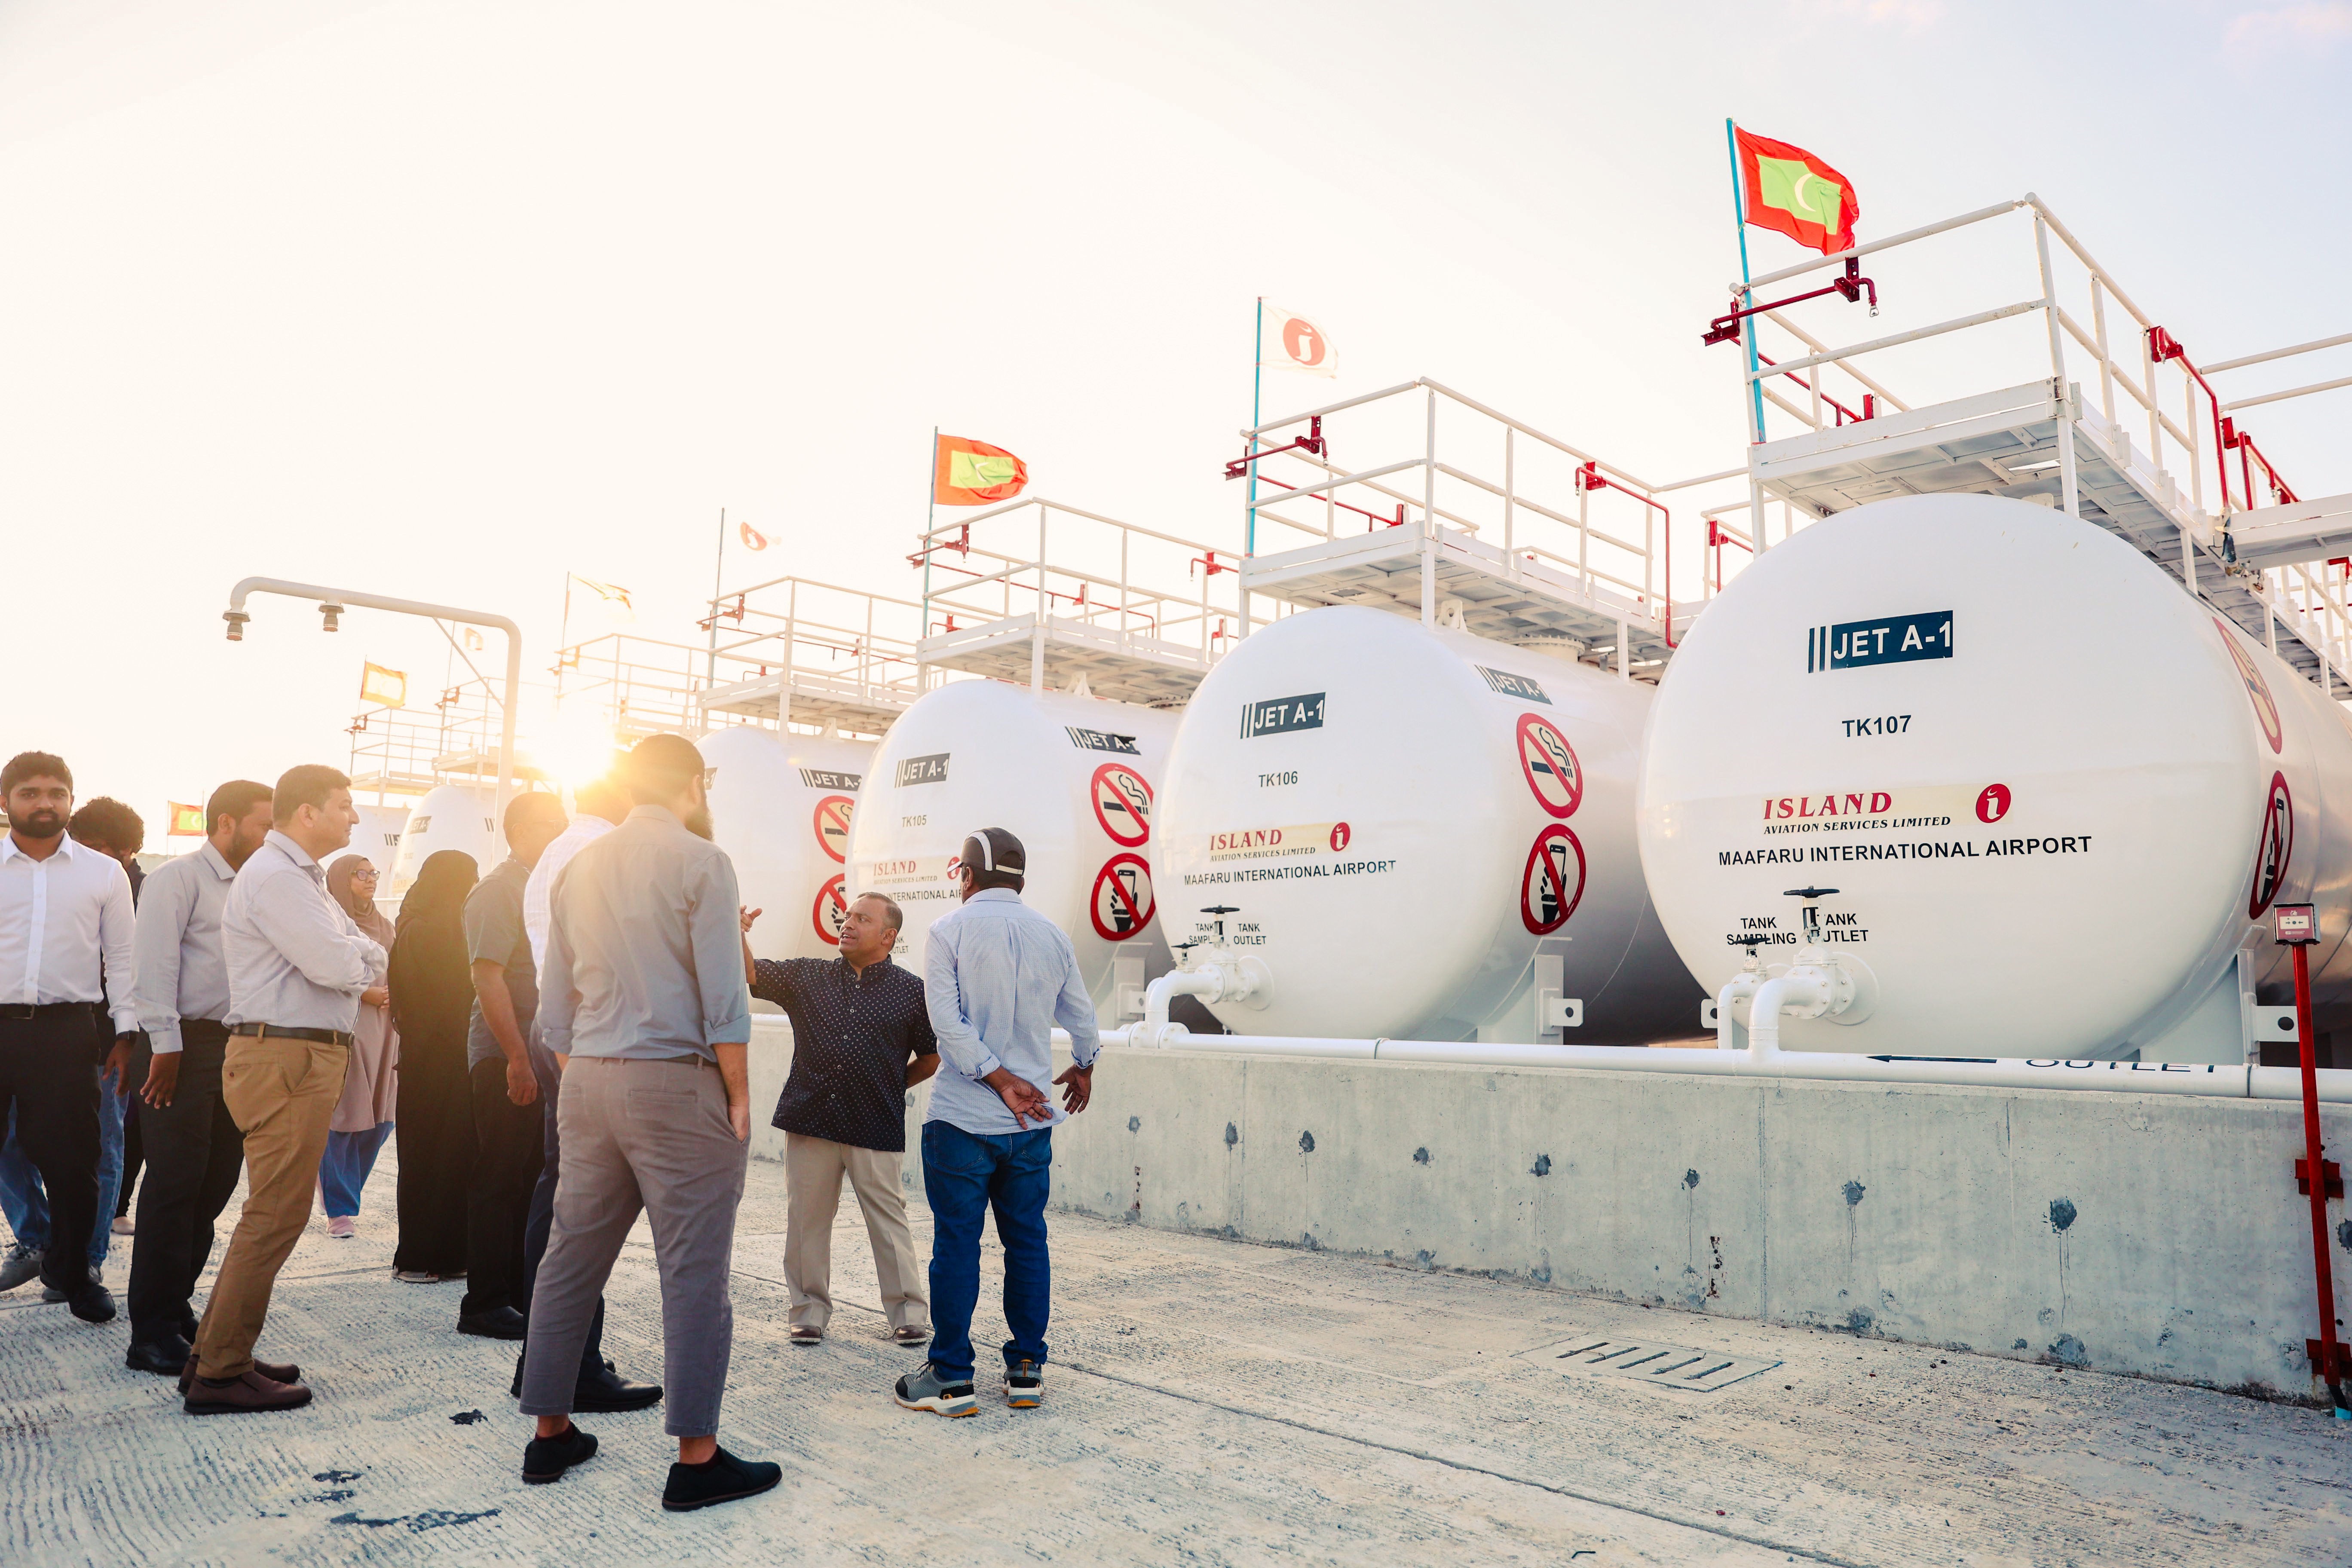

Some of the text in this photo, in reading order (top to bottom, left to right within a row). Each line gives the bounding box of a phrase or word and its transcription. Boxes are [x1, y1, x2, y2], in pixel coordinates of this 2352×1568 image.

[1833, 621, 1950, 659] JET A-1
[1494, 673, 1548, 699] JET A-1
[1255, 699, 1324, 729] JET A-1
[1842, 714, 1911, 737] TK107
[1083, 732, 1110, 747] JET
[904, 759, 949, 781] JET A-1
[815, 773, 838, 786] JET
[1259, 771, 1298, 787] TK106
[1764, 792, 1892, 820] ISLAND
[902, 815, 927, 828] TK105
[1764, 816, 1951, 835] AVIATION SERVICES LIMITED
[1210, 829, 1282, 850] ISLAND
[1210, 846, 1316, 862] AVIATION SERVICES LIMITED
[1719, 836, 2092, 866] MAAFARU INTERNATIONAL AIRPORT
[874, 861, 916, 876] ISLAND
[1185, 860, 1396, 885] MAAFARU INTERNATIONAL AIRPORT
[1740, 917, 1777, 929] TANK
[1817, 913, 1857, 925] ANK
[1196, 923, 1214, 932] TANK
[1238, 923, 1260, 932] TANK
[1234, 935, 1266, 945] OUTLET
[1823, 930, 1868, 942] UTLET
